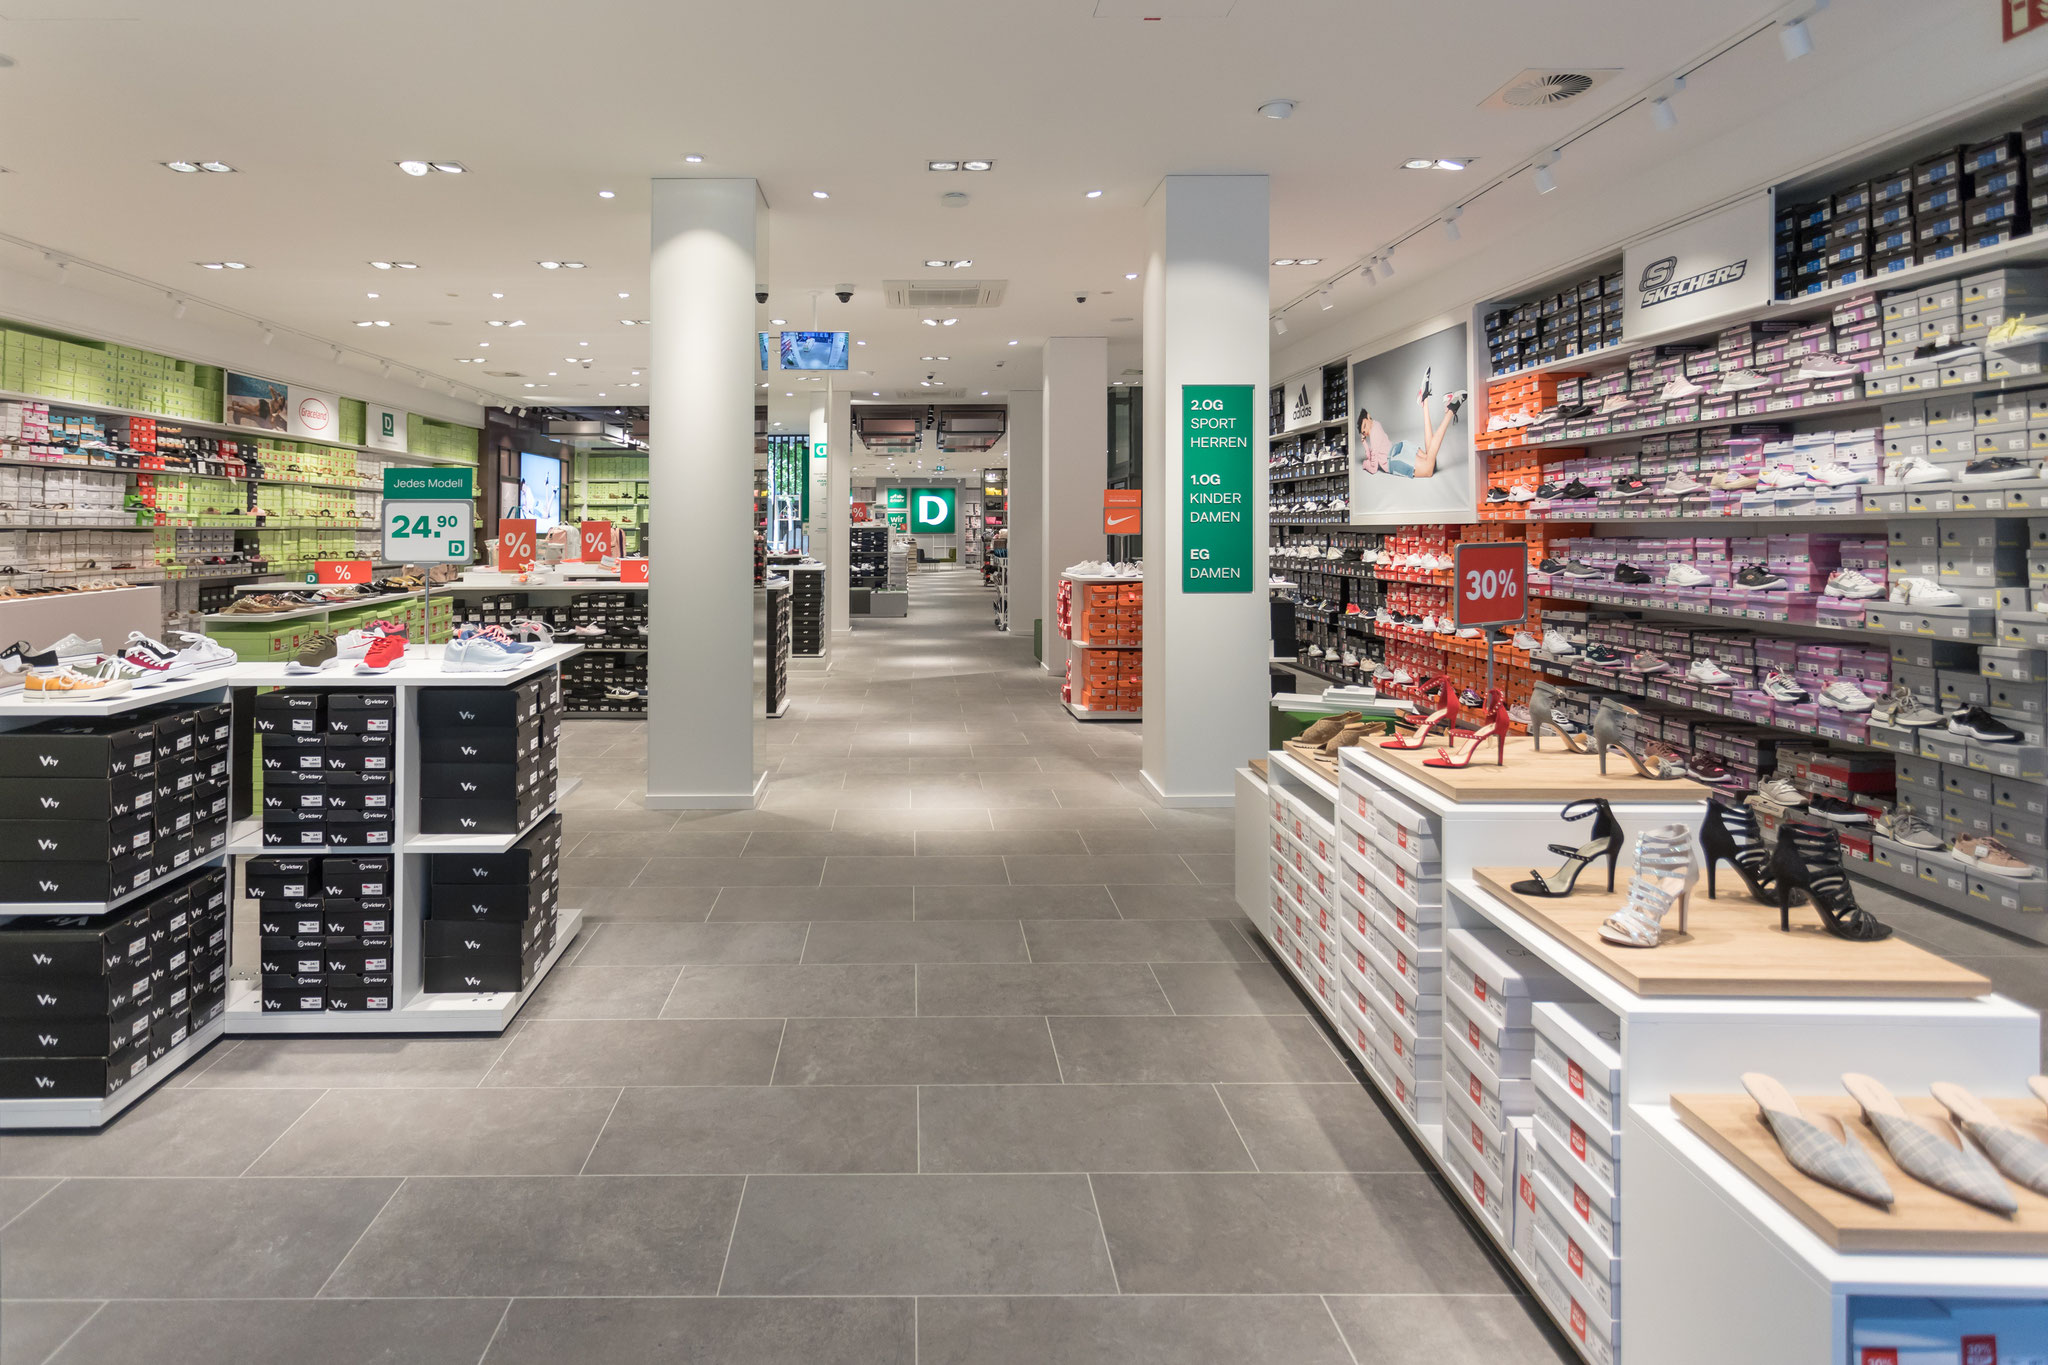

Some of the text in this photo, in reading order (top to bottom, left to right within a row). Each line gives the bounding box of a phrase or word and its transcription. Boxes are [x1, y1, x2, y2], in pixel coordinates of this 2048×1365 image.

[1641, 260, 1747, 308] SKECHERS
[1190, 399, 1223, 411] 2.OG
[301, 408, 327, 421] Graceland
[1293, 406, 1312, 420] adidas
[384, 416, 392, 429] D
[1190, 417, 1237, 430] SPORT
[1190, 436, 1248, 448] HERREN
[393, 479, 463, 489] Jedes Modell
[1190, 474, 1221, 486] 1.OG
[1189, 492, 1242, 504] KINDER
[919, 495, 948, 526] D
[1189, 511, 1241, 523] DAMEN
[451, 543, 463, 554] D
[1190, 548, 1210, 560] EG
[1189, 567, 1241, 579] DAMEN
[1465, 568, 1517, 601] 30%
[459, 711, 475, 720] Vty
[259, 721, 274, 730] Vty
[332, 722, 348, 731] Vty
[198, 734, 209, 744] Vty
[159, 746, 171, 757] Vty
[461, 746, 477, 755] Vty
[39, 755, 59, 767] Vty
[265, 759, 281, 768] Vty
[329, 759, 345, 769] Vty
[112, 762, 126, 773] Vty
[195, 772, 205, 782] Vty
[159, 786, 171, 797] Vty
[461, 782, 477, 791] Vty
[40, 797, 60, 809] Vty
[266, 798, 282, 807] Vty
[329, 798, 345, 807] Vty
[114, 804, 128, 815] Vty
[196, 809, 207, 819] Vty
[460, 818, 477, 827] Vty
[159, 827, 170, 838] Vty
[266, 834, 281, 843] Vty
[331, 834, 347, 844] Vty
[38, 839, 59, 851] Vty
[112, 844, 126, 856] Vty
[194, 846, 205, 856] Vty
[156, 864, 167, 876] Vty
[473, 868, 488, 877] Vty
[39, 881, 59, 892] Vty
[113, 885, 126, 896] Vty
[326, 887, 342, 895] Vty
[249, 888, 265, 897] Vty
[192, 908, 202, 919] Vty
[472, 905, 488, 914] Vty
[263, 924, 279, 932] Vty
[328, 924, 344, 932] Vty
[152, 930, 164, 941] Vty
[465, 940, 481, 949] Vty
[193, 946, 204, 957] Vty
[33, 954, 53, 966] Vty
[107, 955, 121, 967] Vty
[263, 963, 279, 971] Vty
[330, 962, 346, 971] Vty
[152, 969, 164, 981] Vty
[465, 976, 481, 986] Vty
[193, 983, 204, 994] Vty
[37, 994, 57, 1006] Vty
[112, 995, 125, 1007] Vty
[265, 1000, 281, 1009] Vty
[331, 1000, 347, 1009] Vty
[153, 1007, 164, 1019] Vty
[194, 1019, 204, 1030] Vty
[38, 1034, 59, 1046] Vty
[113, 1037, 126, 1049] Vty
[153, 1047, 165, 1059] Vty
[35, 1076, 56, 1088] Vty
[110, 1078, 123, 1091] Vty
[1966, 1343, 1992, 1354] 30%
